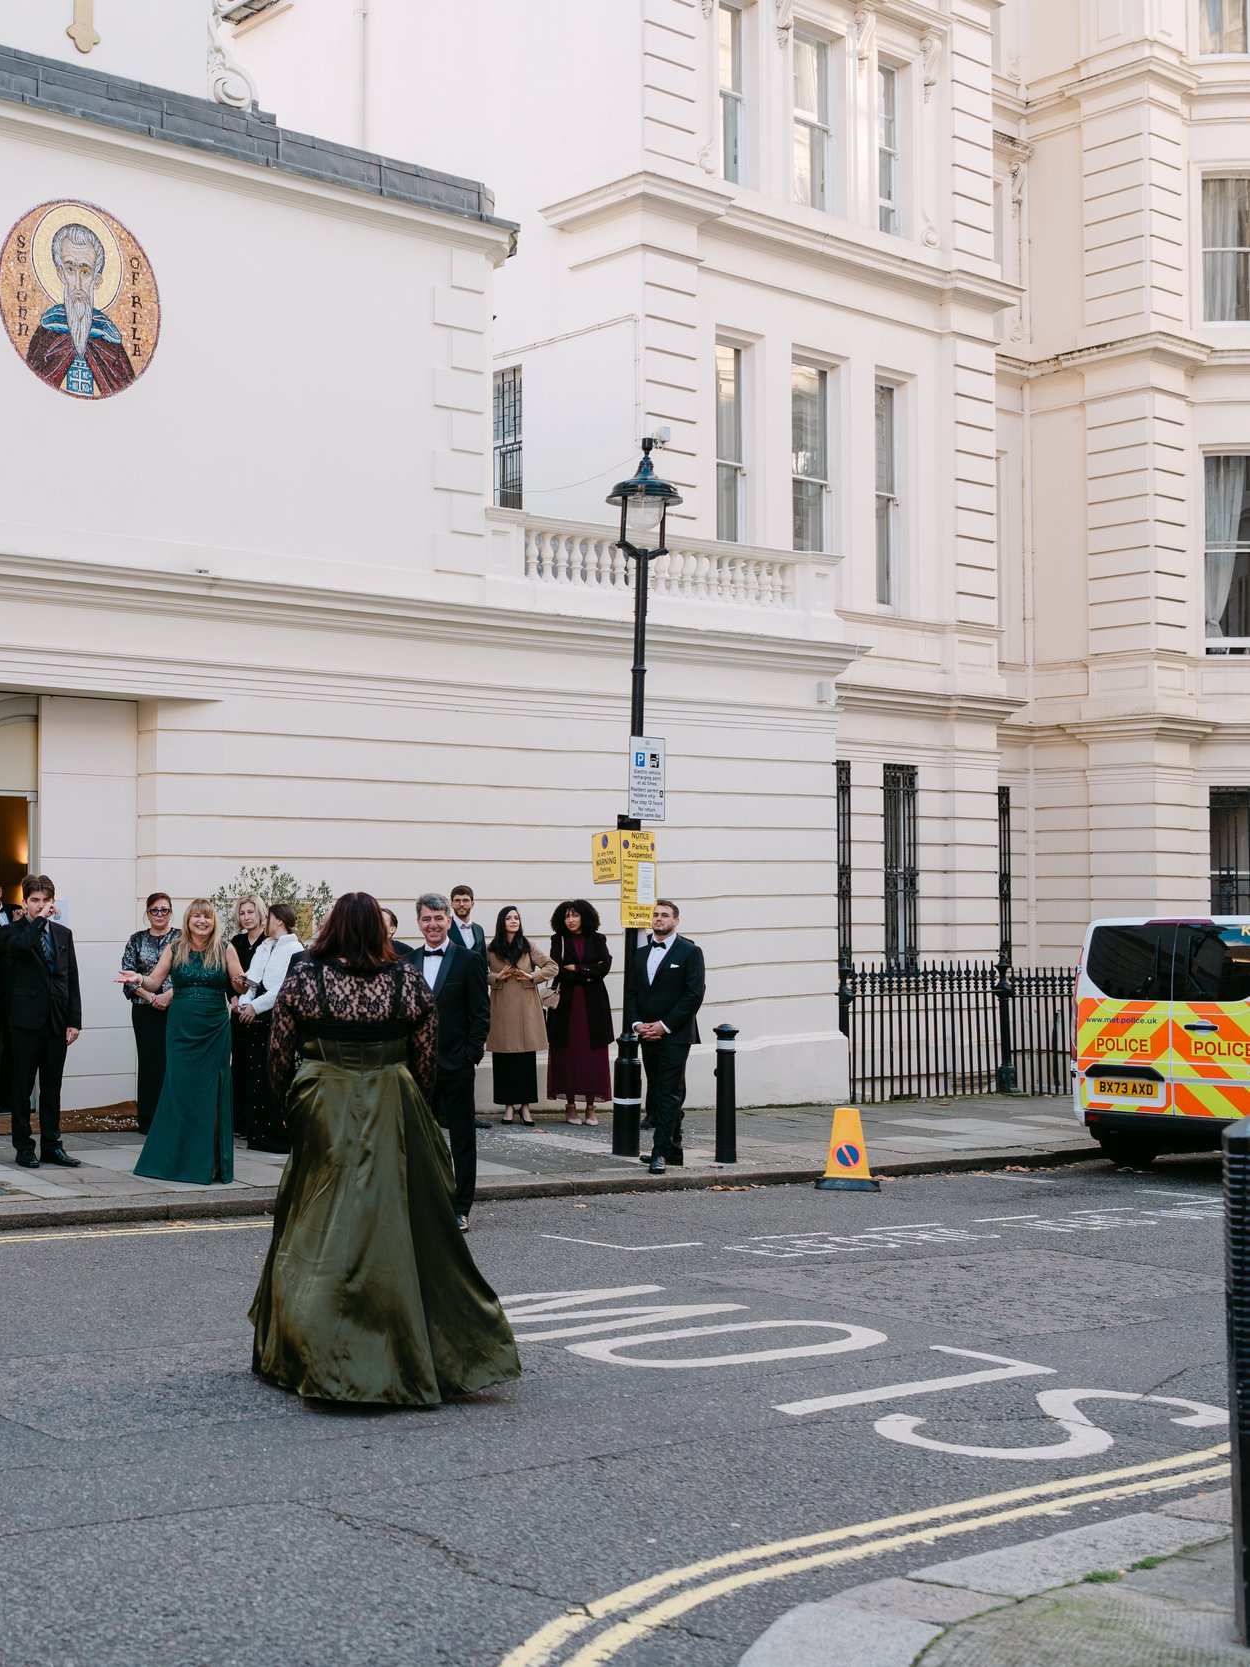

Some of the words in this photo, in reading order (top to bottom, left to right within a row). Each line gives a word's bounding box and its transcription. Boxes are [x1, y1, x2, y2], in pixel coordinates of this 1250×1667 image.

[129, 257, 141, 286] OF
[131, 296, 142, 357] RILA
[631, 832, 649, 840] NOTICE
[627, 850, 653, 859] Suspended
[632, 843, 649, 851] Parking
[596, 856, 617, 866] WARNING
[1086, 1017, 1158, 1025] www.met.police.uk
[1096, 1037, 1149, 1053] POLICE
[1099, 1081, 1128, 1094] BX73
[1131, 1083, 1153, 1096] AXD
[721, 1228, 1001, 1258] ELECTRIC
[498, 1284, 1230, 1460] SLOW
